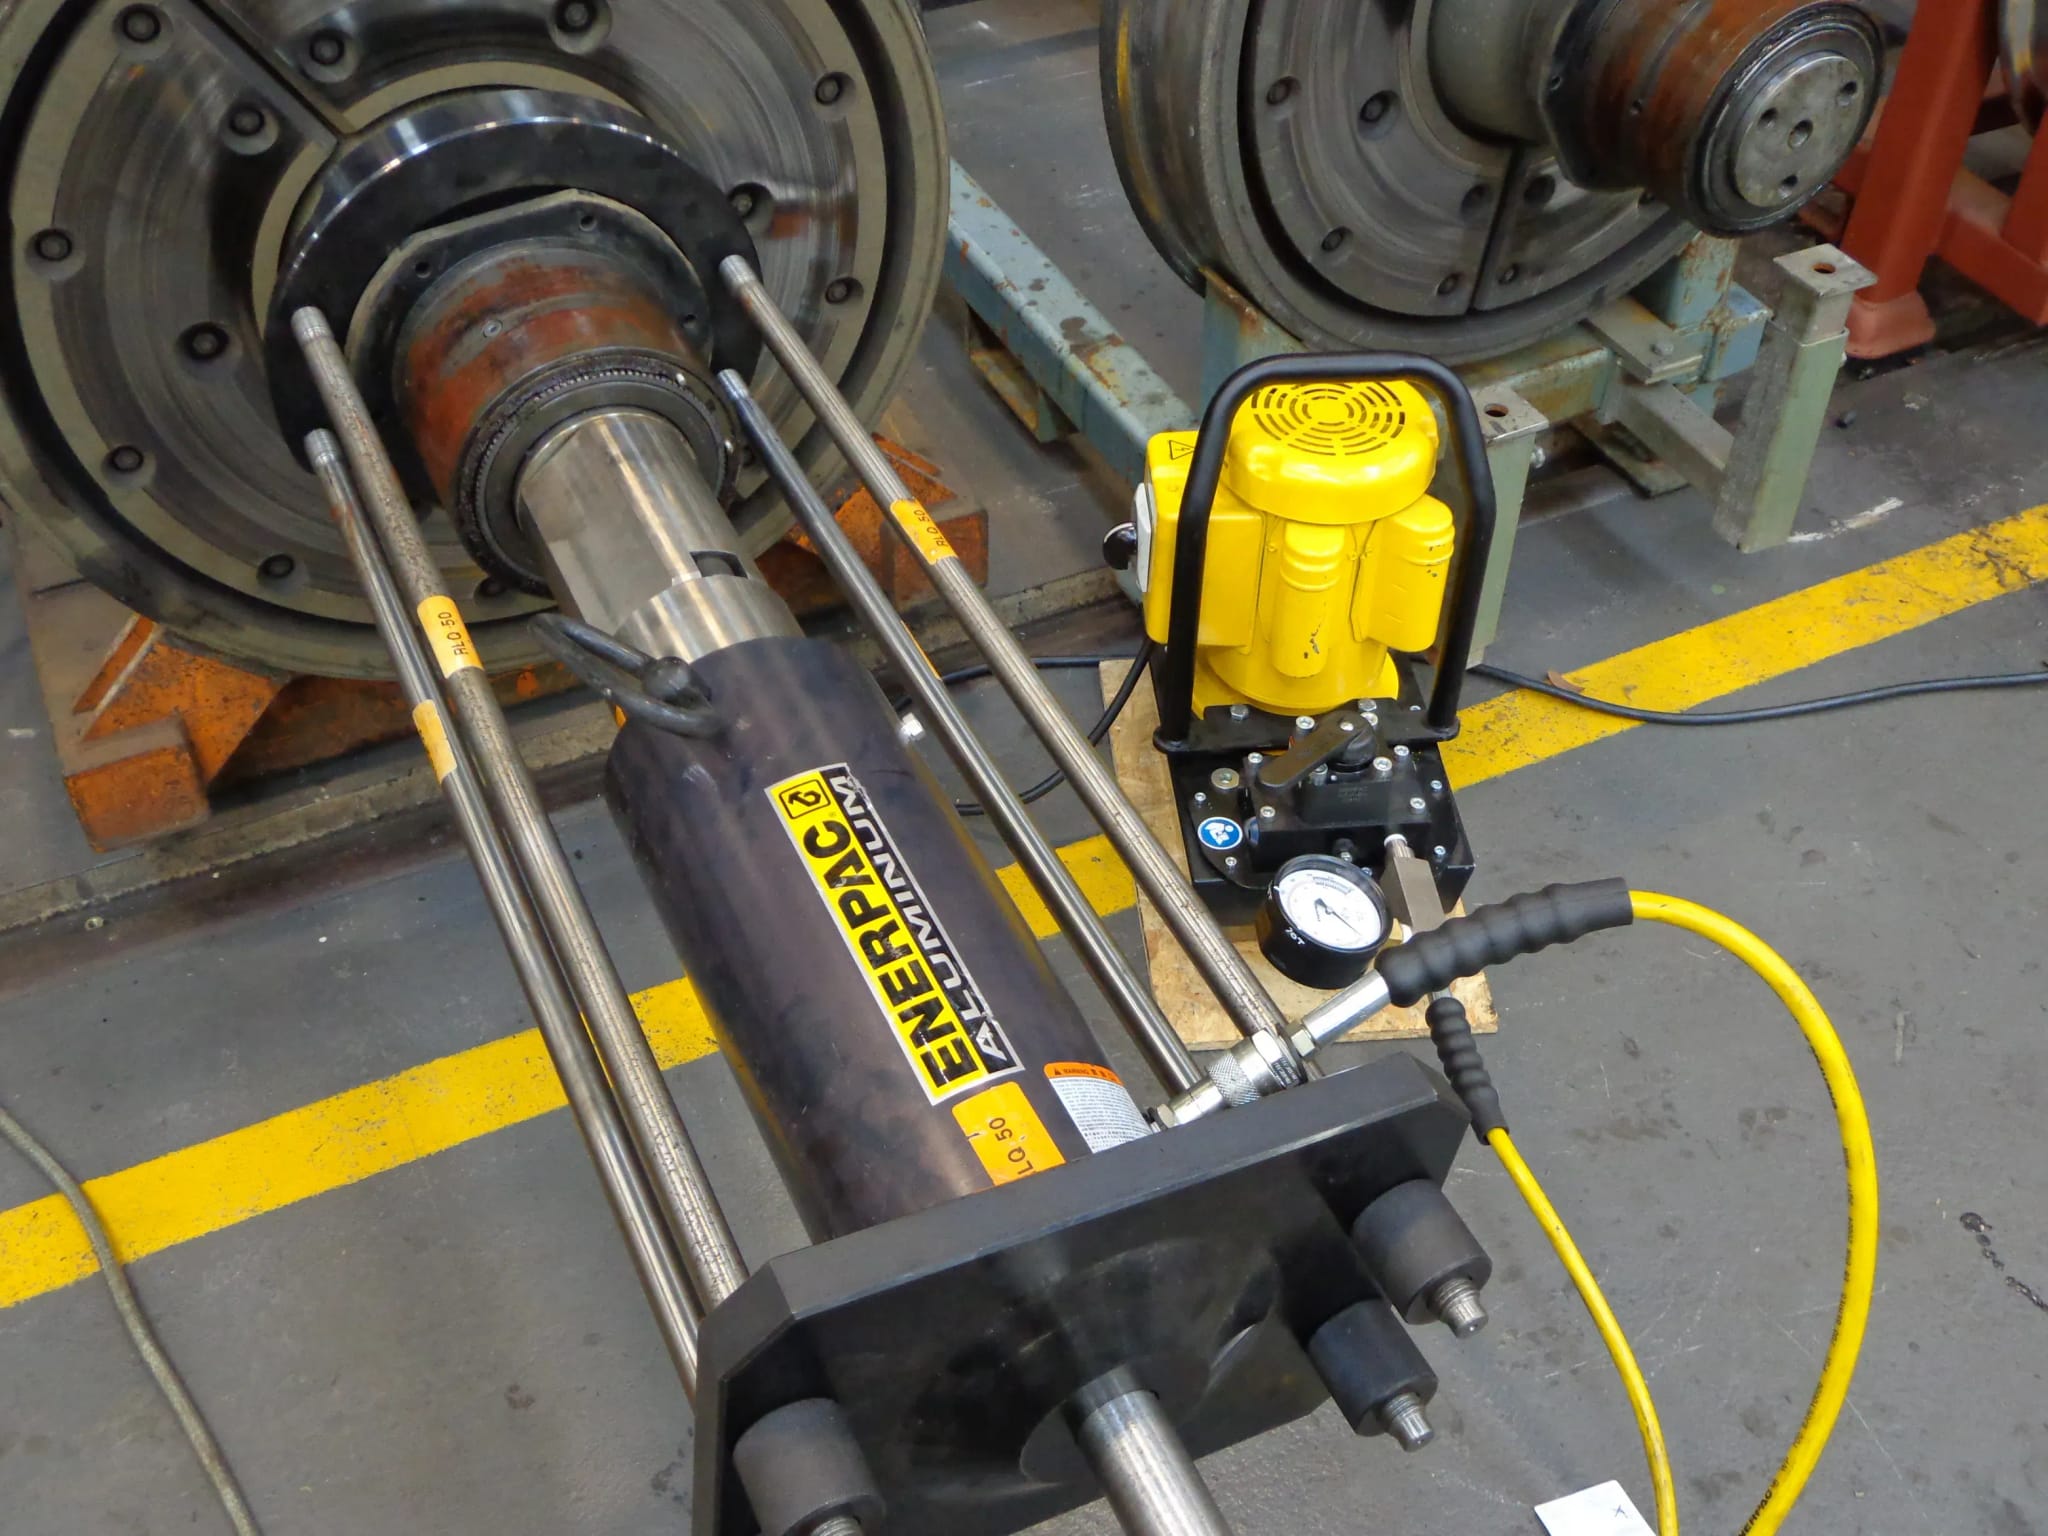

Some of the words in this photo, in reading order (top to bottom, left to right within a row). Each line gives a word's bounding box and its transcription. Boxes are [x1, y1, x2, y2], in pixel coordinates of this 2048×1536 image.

[437, 611, 456, 627] 50
[802, 819, 980, 1089] ENERPAC
[829, 775, 1008, 1062] ALUMINUM
[988, 1117, 1013, 1142] 50
